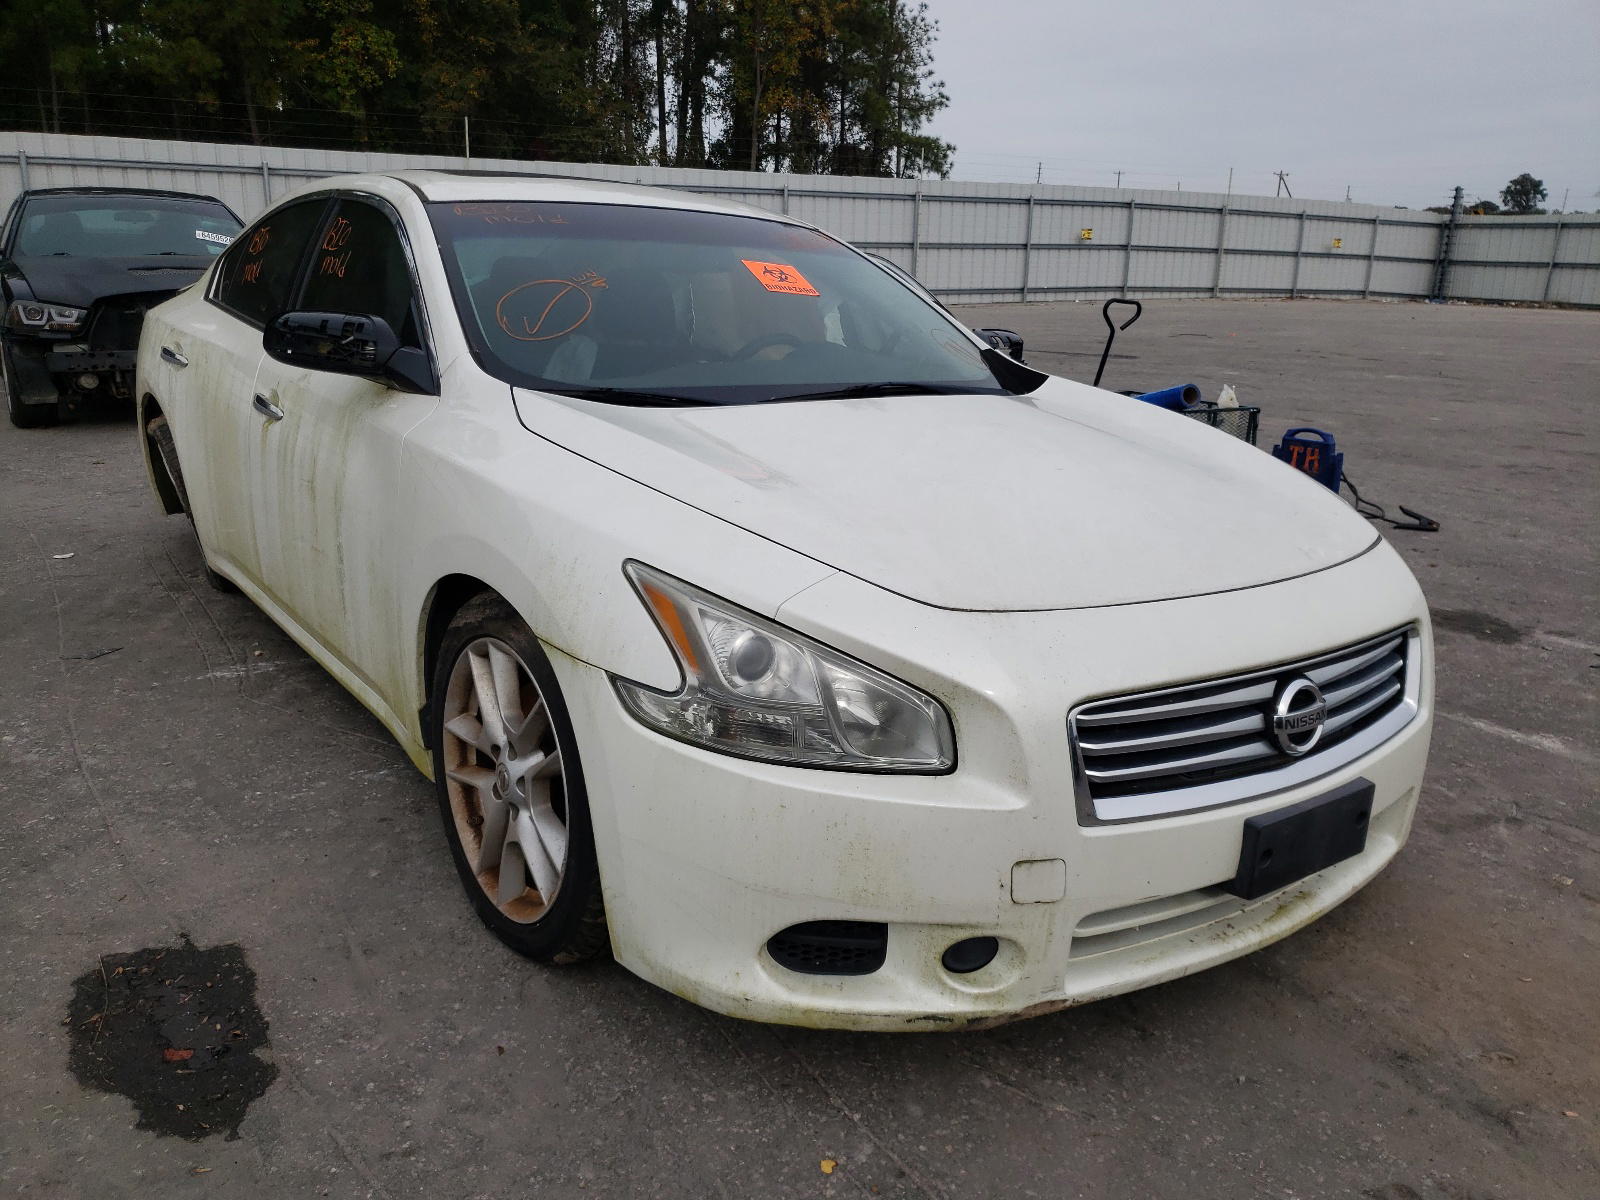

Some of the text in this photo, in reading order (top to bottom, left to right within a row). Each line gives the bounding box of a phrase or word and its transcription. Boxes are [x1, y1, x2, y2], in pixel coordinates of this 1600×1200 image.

[764, 283, 817, 295] BIOHAZARD
[1289, 445, 1320, 473] TH
[1284, 708, 1327, 730] NISSAN
